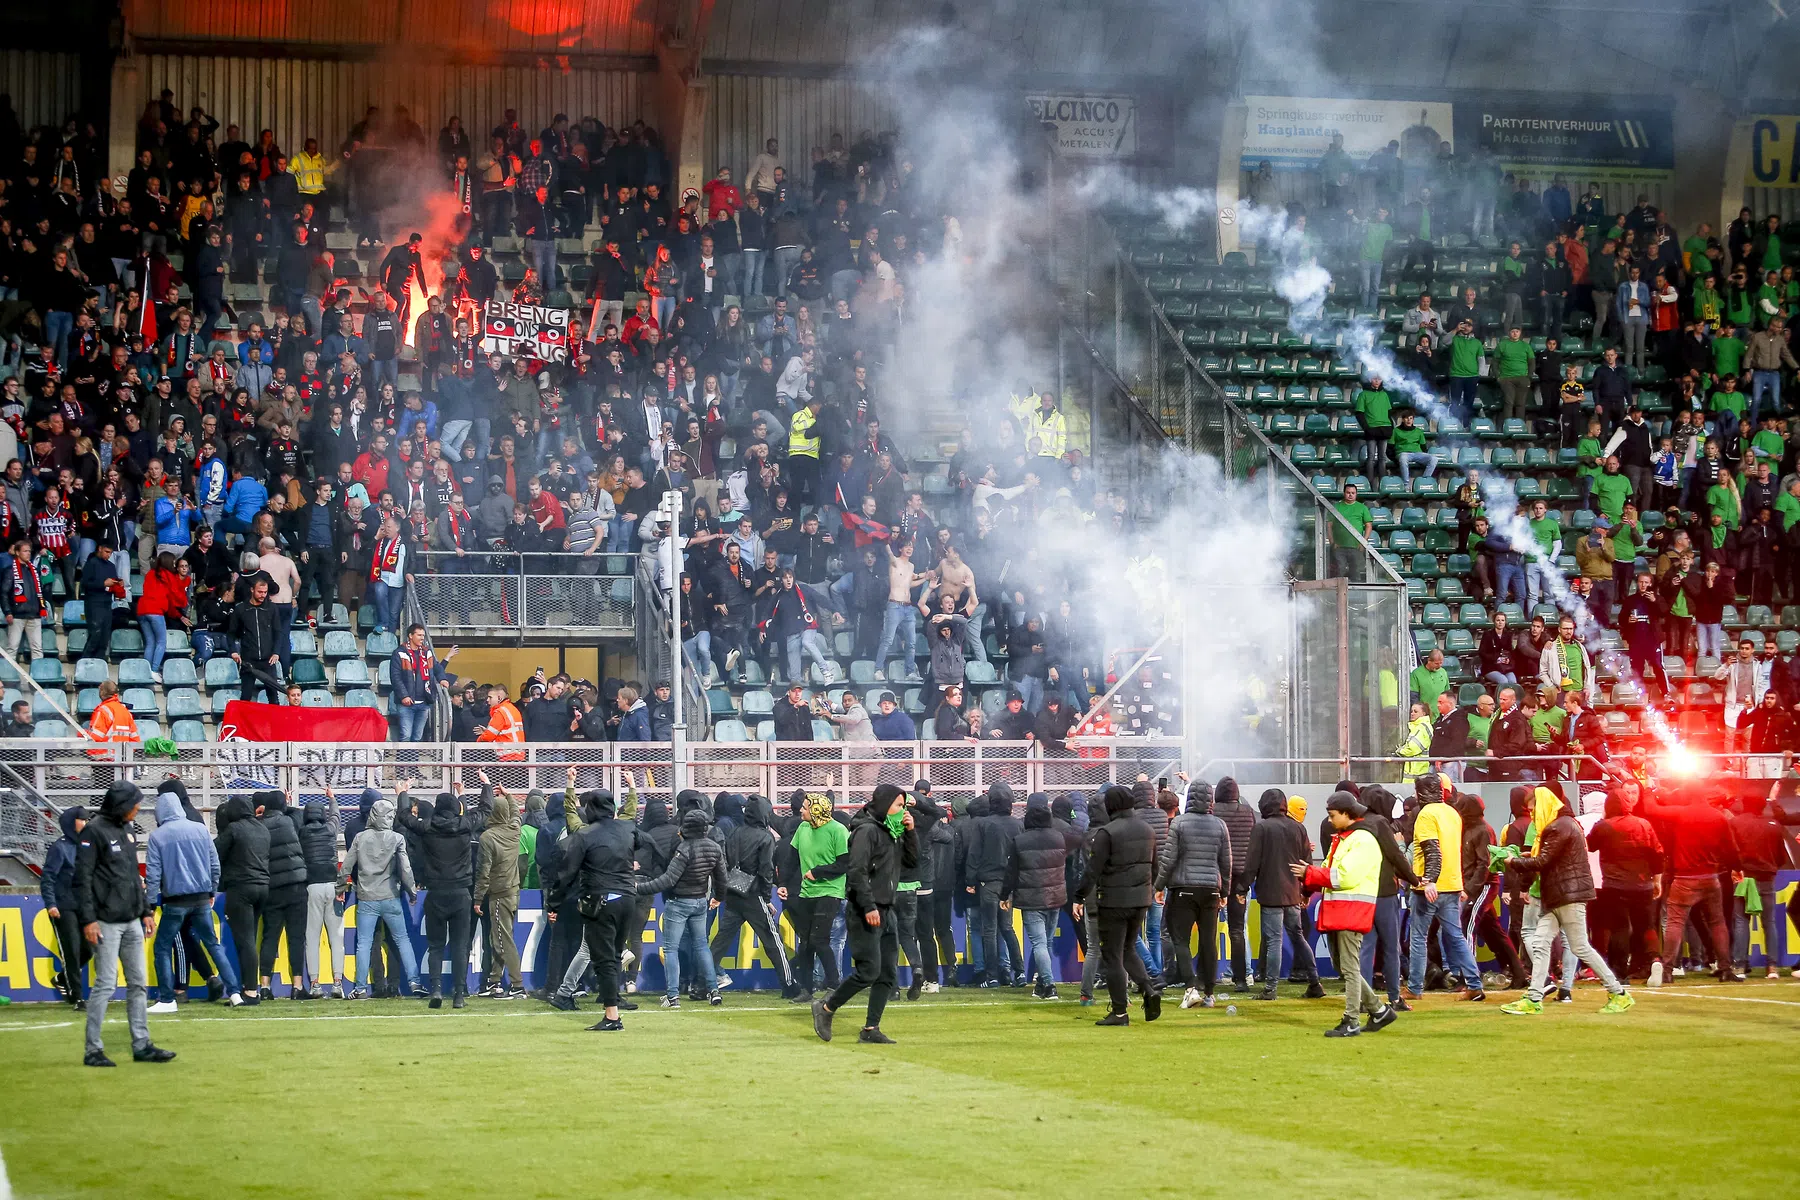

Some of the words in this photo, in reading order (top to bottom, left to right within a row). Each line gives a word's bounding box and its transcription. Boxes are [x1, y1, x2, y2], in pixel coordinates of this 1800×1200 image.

[1028, 99, 1120, 123] ELCINCO
[1257, 107, 1385, 123] Springkussenverhuur
[1257, 124, 1340, 137] Haaglanden
[1492, 131, 1578, 145] HAAGLANDEN
[1060, 139, 1111, 148] METALEN
[487, 301, 564, 325] BRENG
[514, 321, 539, 338] ONS
[486, 335, 566, 364] TERUG
